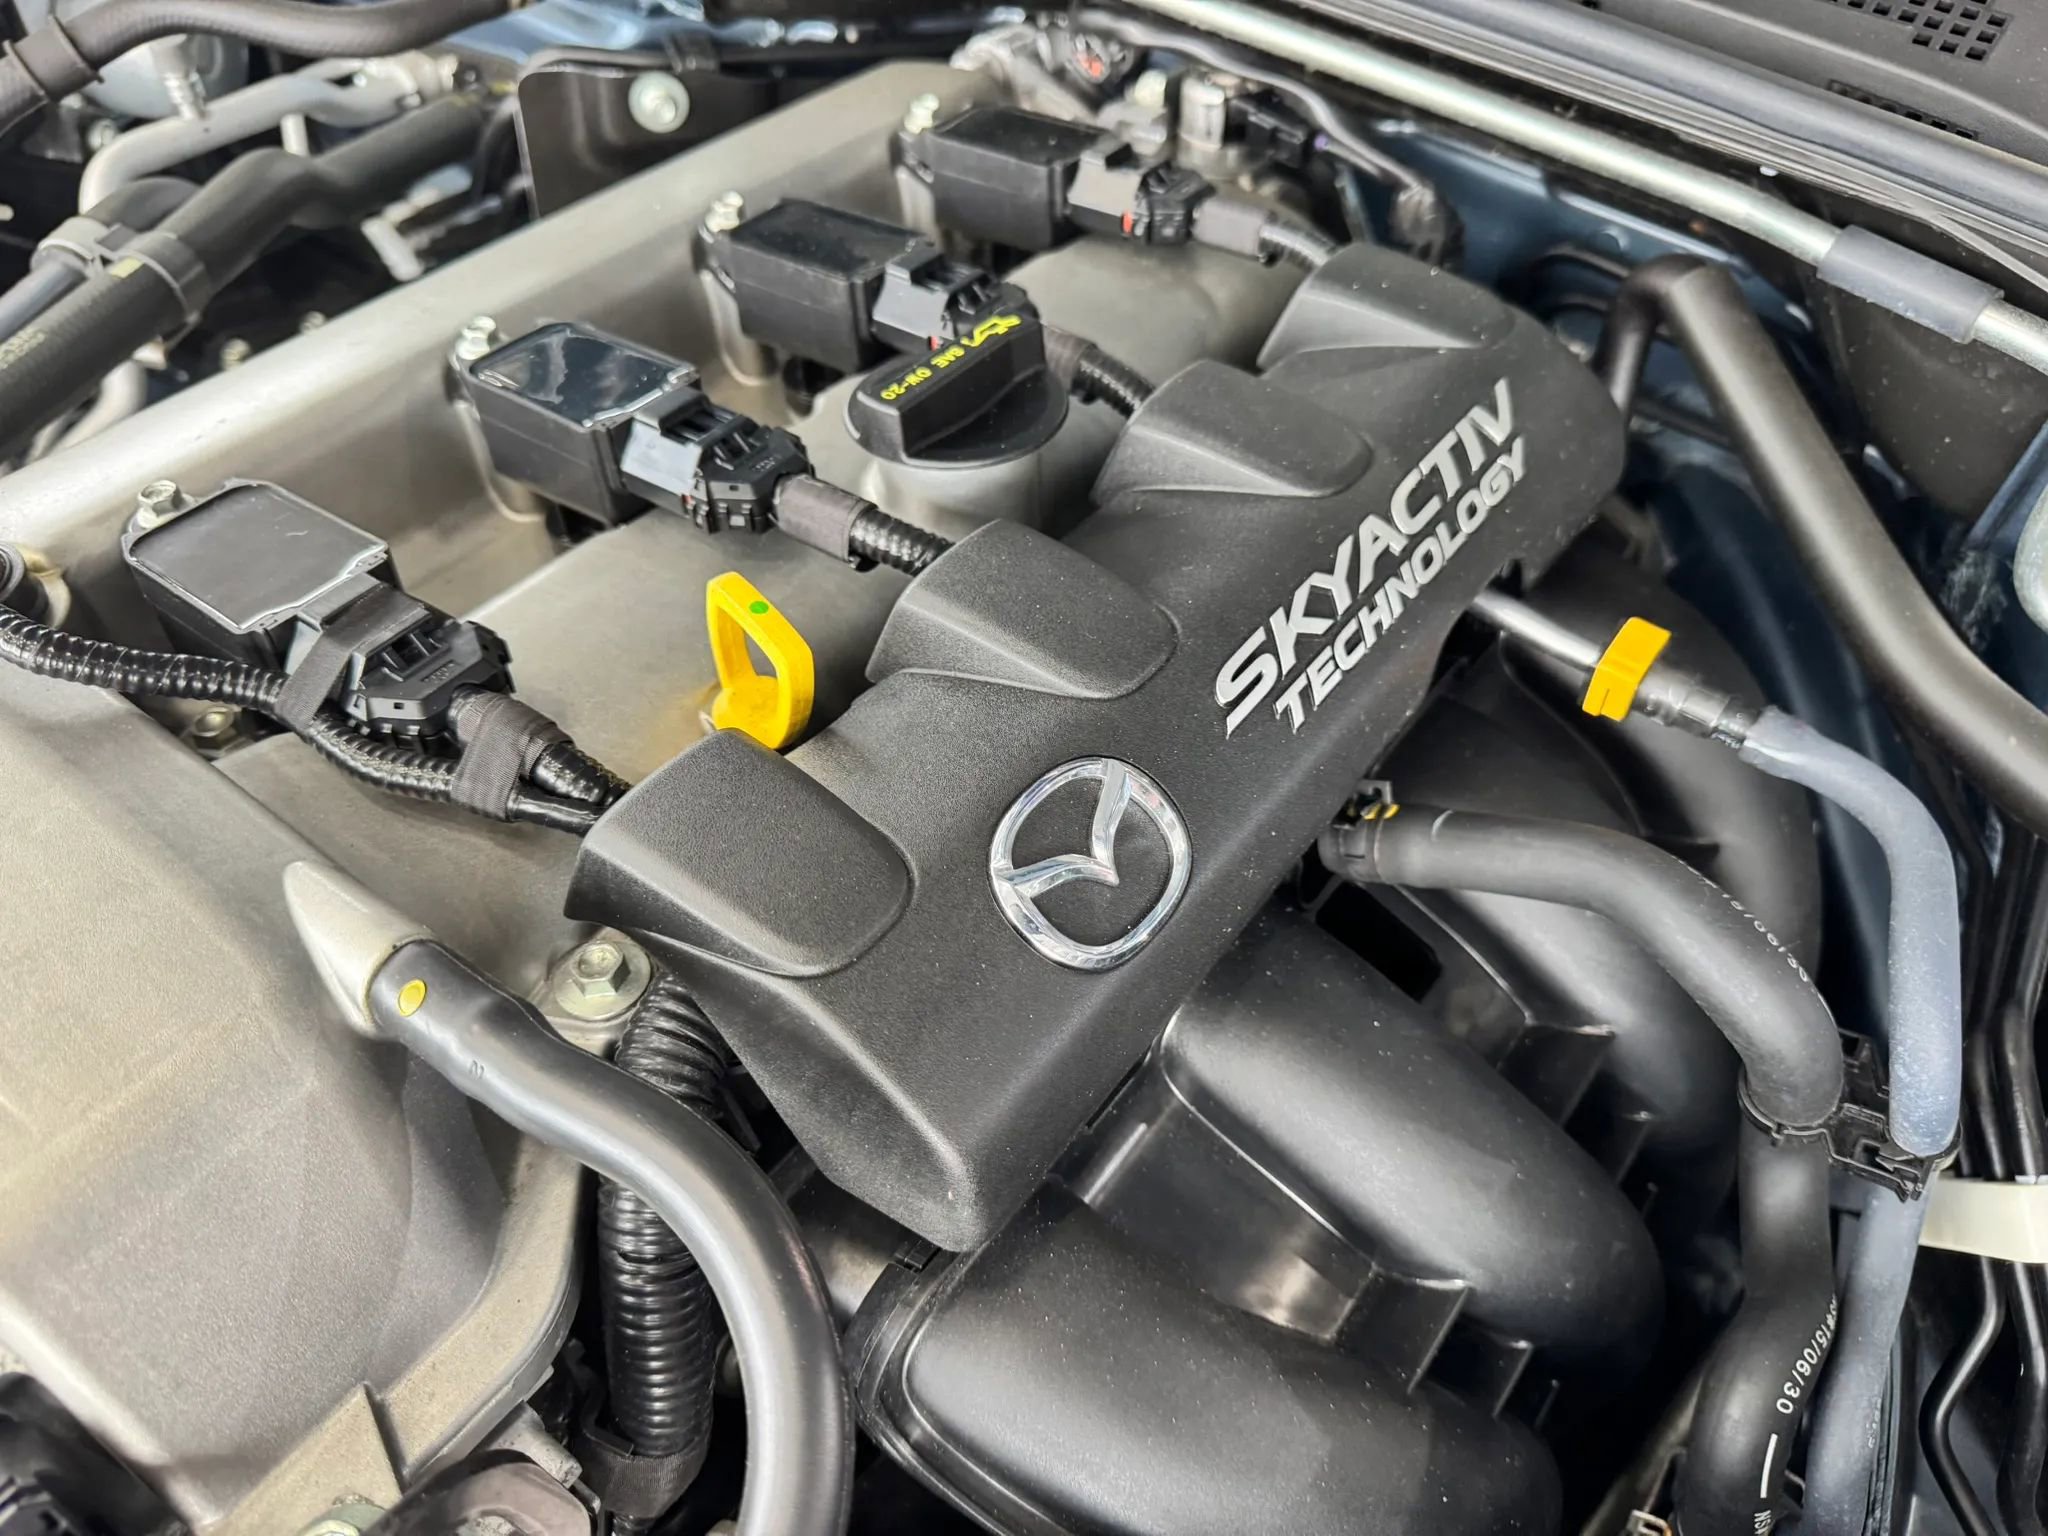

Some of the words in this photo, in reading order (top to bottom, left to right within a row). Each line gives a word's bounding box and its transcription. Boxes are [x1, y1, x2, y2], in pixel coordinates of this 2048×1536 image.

[880, 366, 933, 400] 0W-20
[930, 344, 966, 369] SAE
[1214, 377, 1514, 740] SKYACTIV
[1272, 436, 1525, 734] TECHNOLOGY
